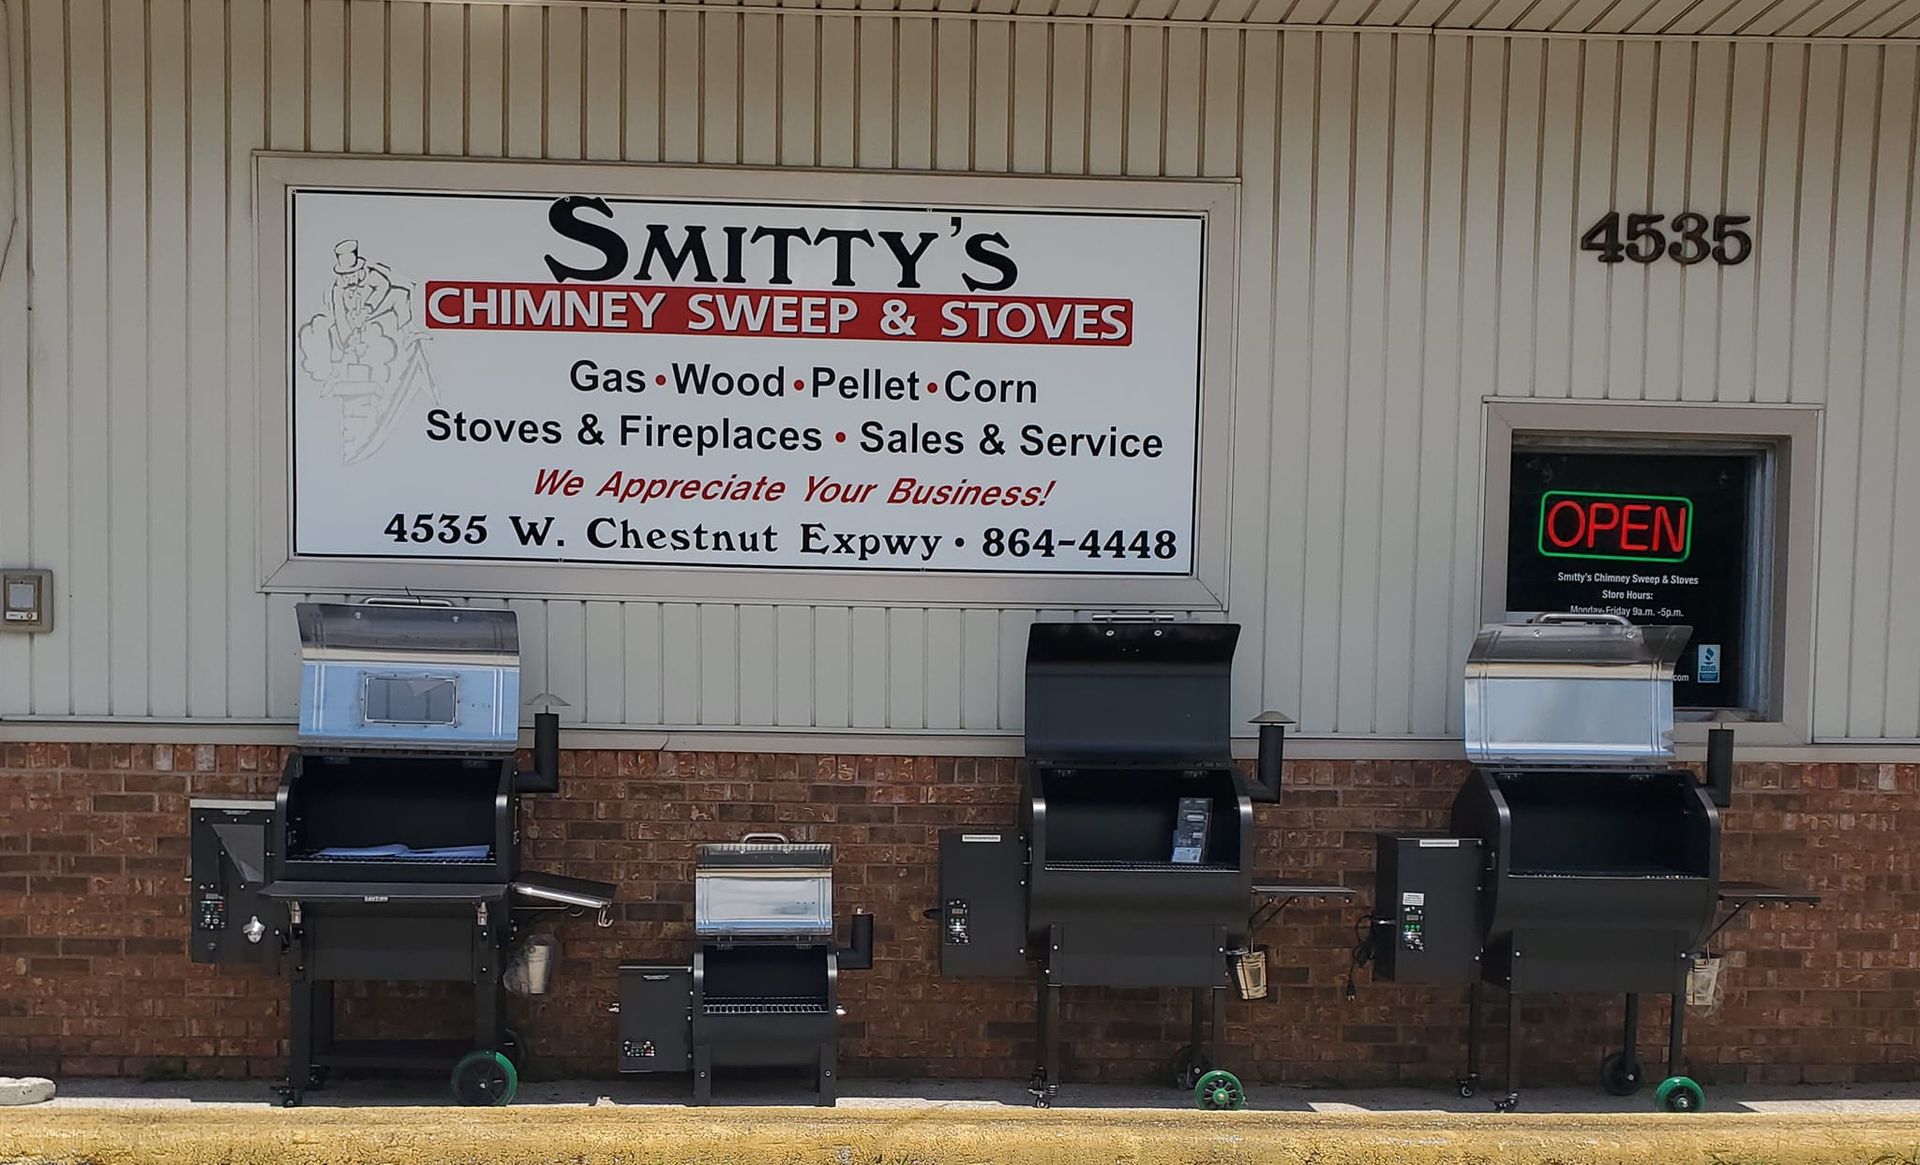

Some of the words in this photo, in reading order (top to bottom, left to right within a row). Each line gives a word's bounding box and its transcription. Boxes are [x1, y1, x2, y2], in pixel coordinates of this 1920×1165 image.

[544, 196, 1019, 293] SMITTY'S
[1581, 212, 1752, 265] 4535
[427, 288, 666, 329] CHIMNEY
[687, 293, 860, 334] SWEEP
[880, 299, 916, 336] &
[941, 300, 1128, 341] STOVES
[570, 360, 646, 393] Gas
[671, 362, 785, 397] Wood
[812, 366, 920, 401] Pellet
[944, 370, 1038, 403] Corn
[426, 409, 562, 444] Stoves
[577, 413, 605, 446] &
[620, 414, 822, 457] Fireplaces
[860, 420, 964, 455] Sales
[979, 423, 1006, 456] &
[1020, 424, 1163, 458] Service
[534, 468, 585, 496] We
[597, 470, 786, 504] Appreciate
[804, 475, 878, 504] Your
[887, 477, 1057, 508] Business!
[383, 513, 488, 545] 4535
[508, 515, 565, 547] W.
[586, 517, 779, 553] Chestnut
[800, 522, 943, 561] Expwy
[982, 527, 1177, 560] 864-4448
[1547, 500, 1687, 553] OPEN
[1557, 571, 1592, 584] Smitty's
[1593, 572, 1631, 585] Chimney
[1632, 573, 1660, 585] Sweep
[1661, 575, 1669, 584] &
[1670, 575, 1699, 585] Stoves
[1601, 589, 1625, 599] Store
[1626, 590, 1654, 600] Hours:
